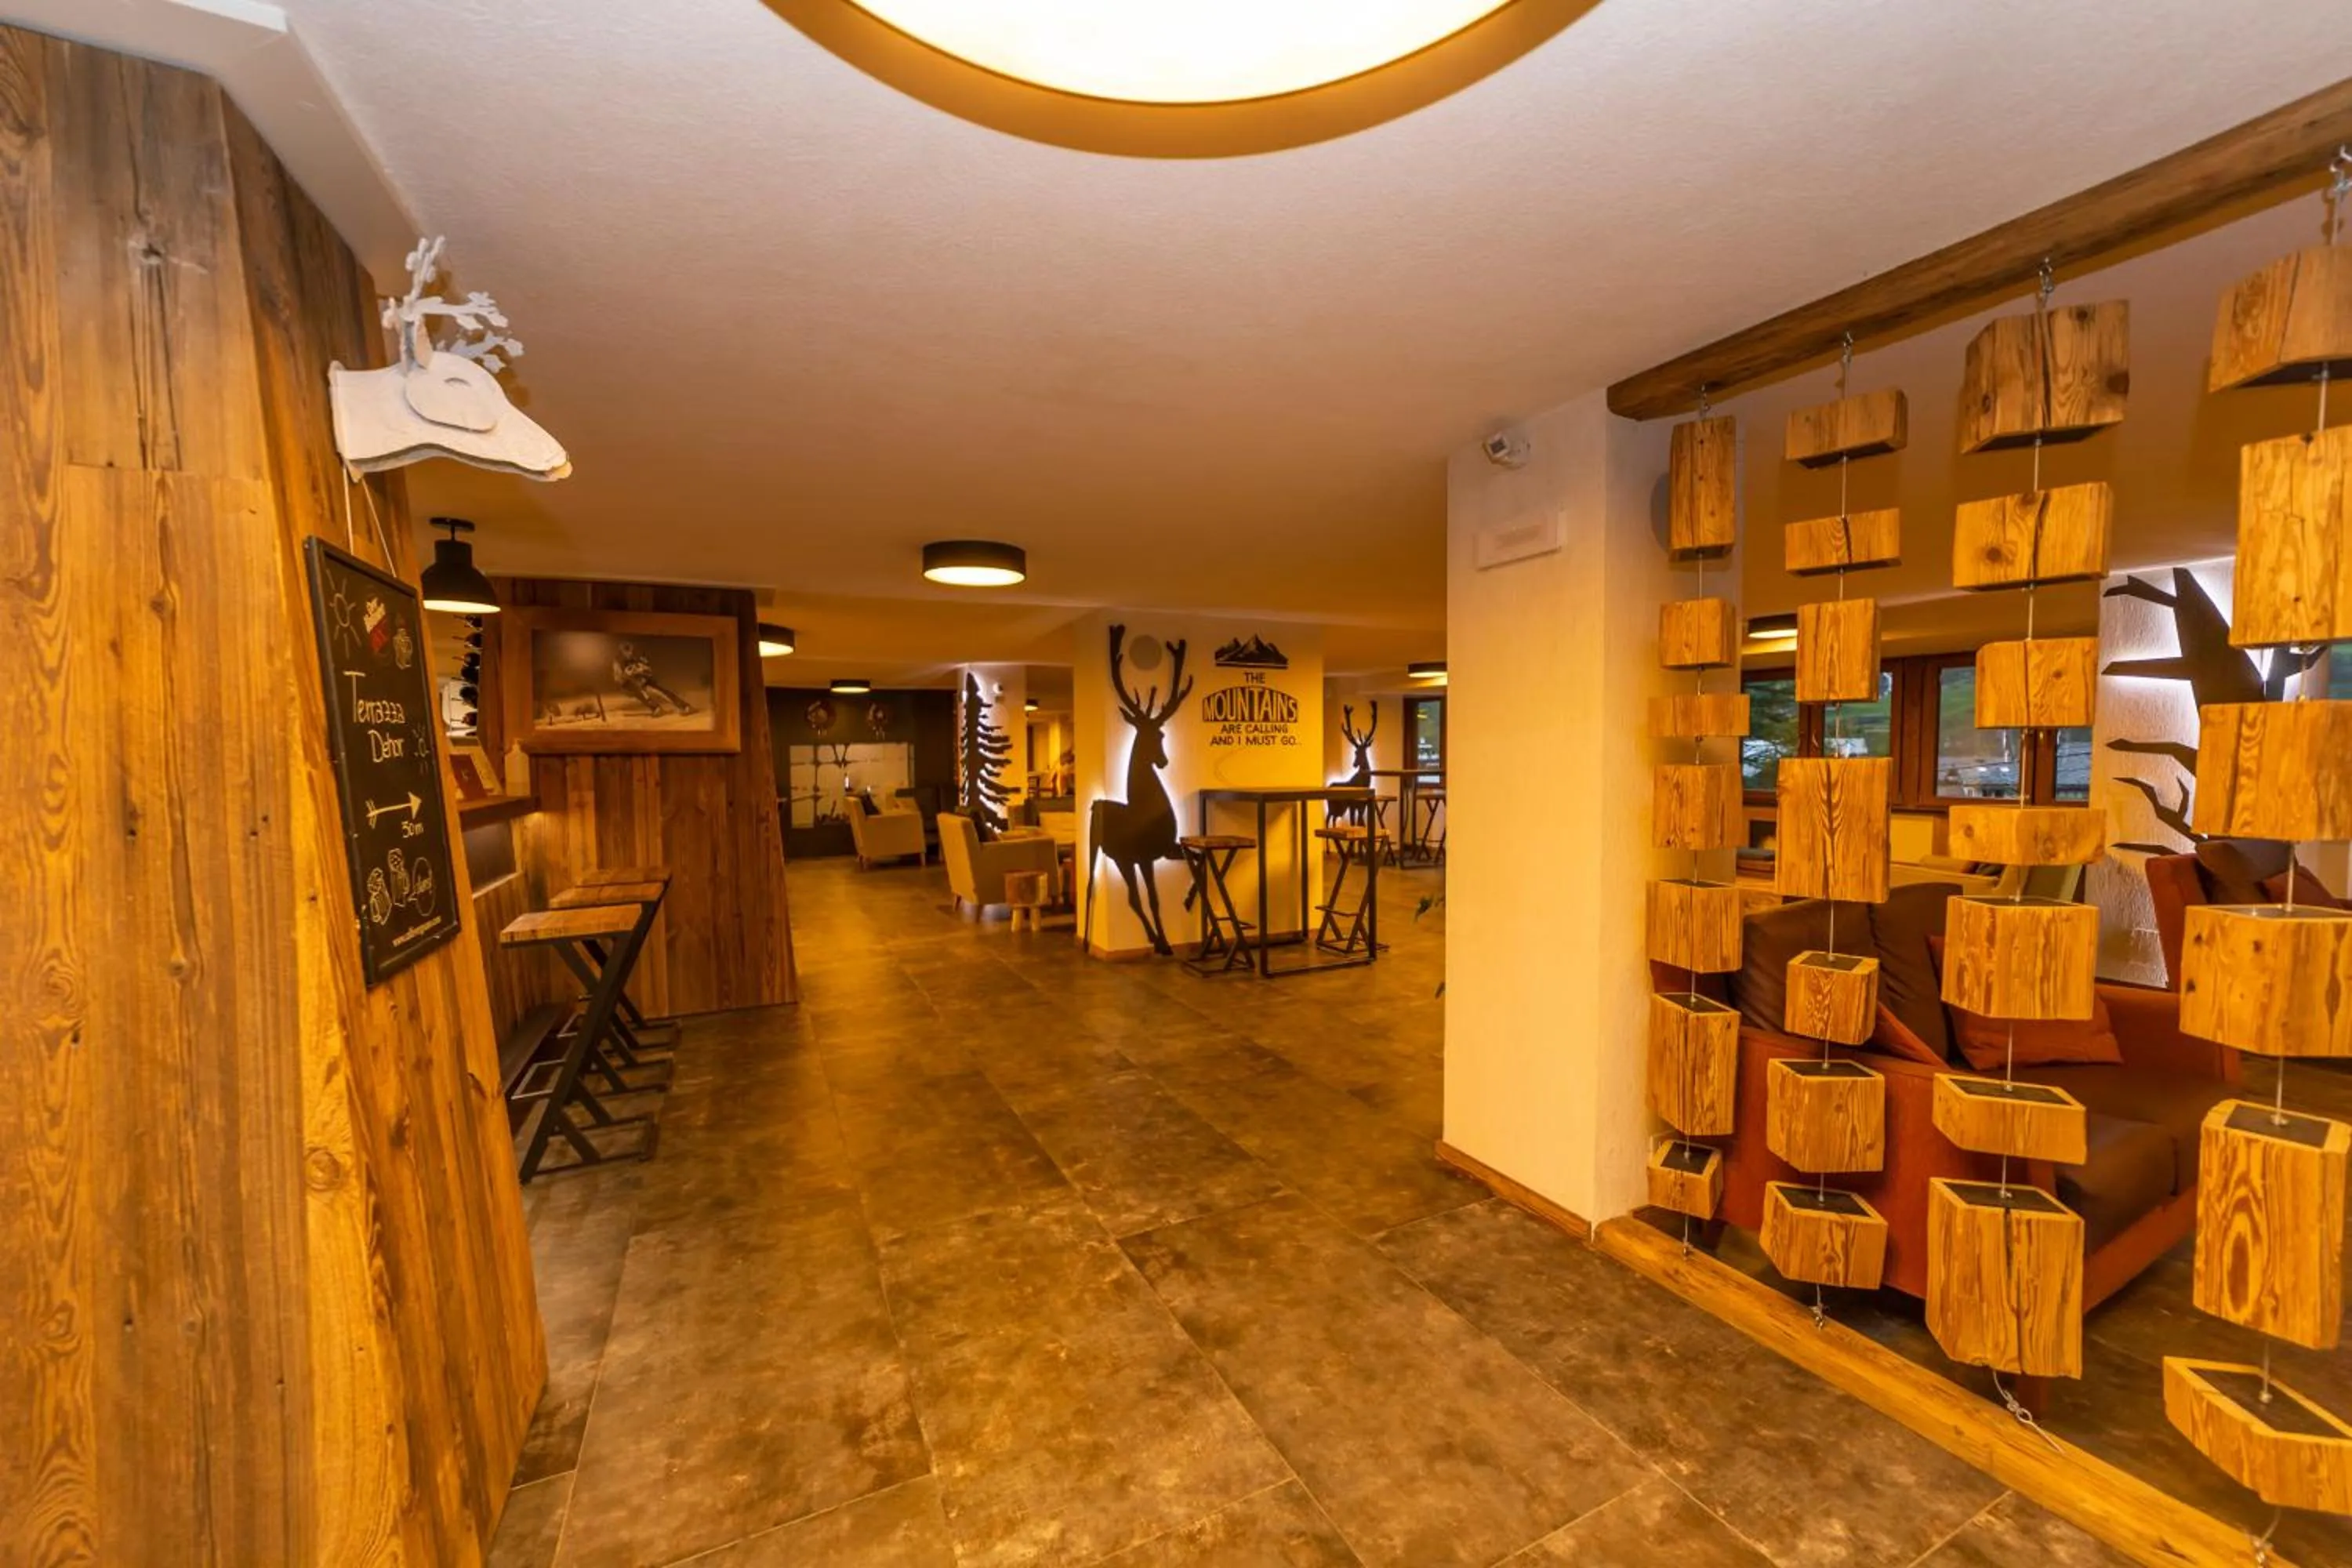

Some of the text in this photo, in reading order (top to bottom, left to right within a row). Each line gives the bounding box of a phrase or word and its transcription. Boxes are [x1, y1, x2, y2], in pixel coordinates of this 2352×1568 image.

[1243, 672, 1265, 684] THE
[343, 670, 405, 724] Terrazza
[1203, 687, 1298, 722] MOUNTAINS
[1221, 724, 1288, 735] ARE CALLING
[1210, 735, 1234, 746] AND
[1247, 735, 1276, 746] MUST
